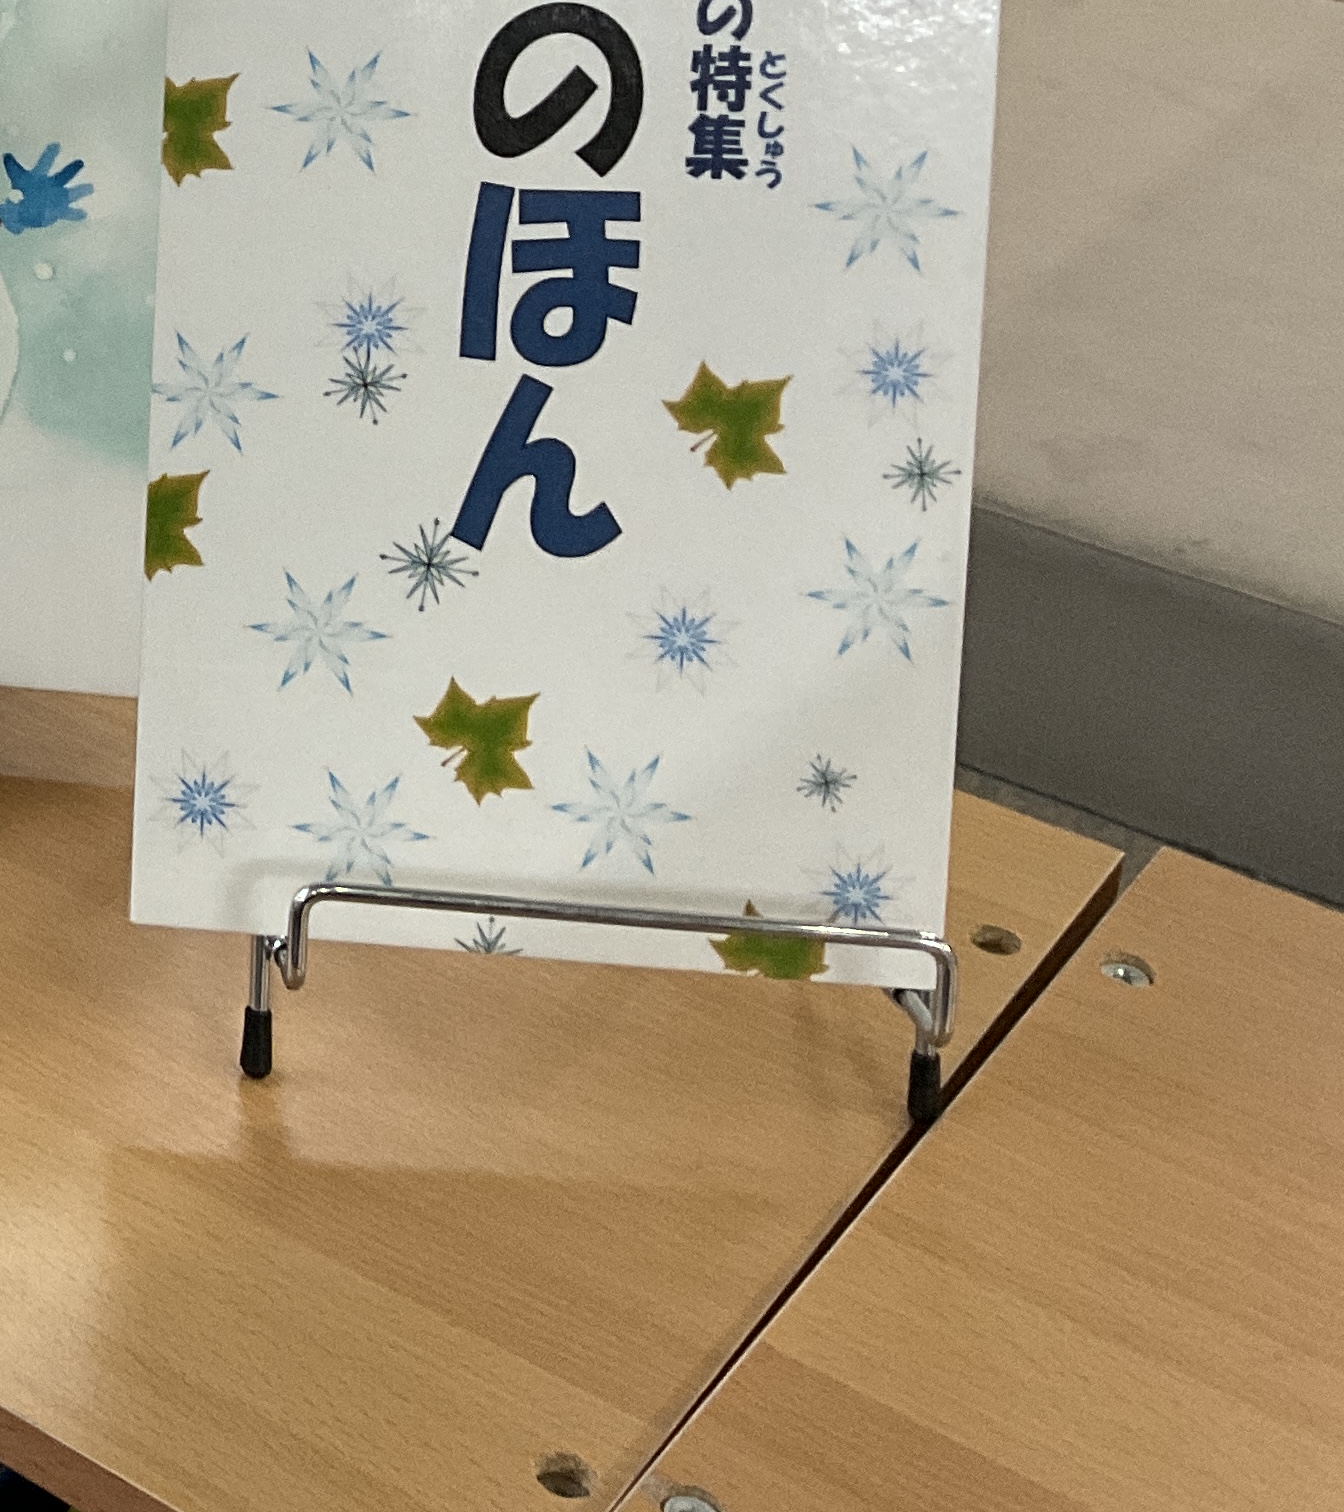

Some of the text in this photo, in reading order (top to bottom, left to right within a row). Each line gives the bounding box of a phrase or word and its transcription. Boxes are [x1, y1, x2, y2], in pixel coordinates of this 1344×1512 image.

[756, 50, 788, 190] とくしゅう
